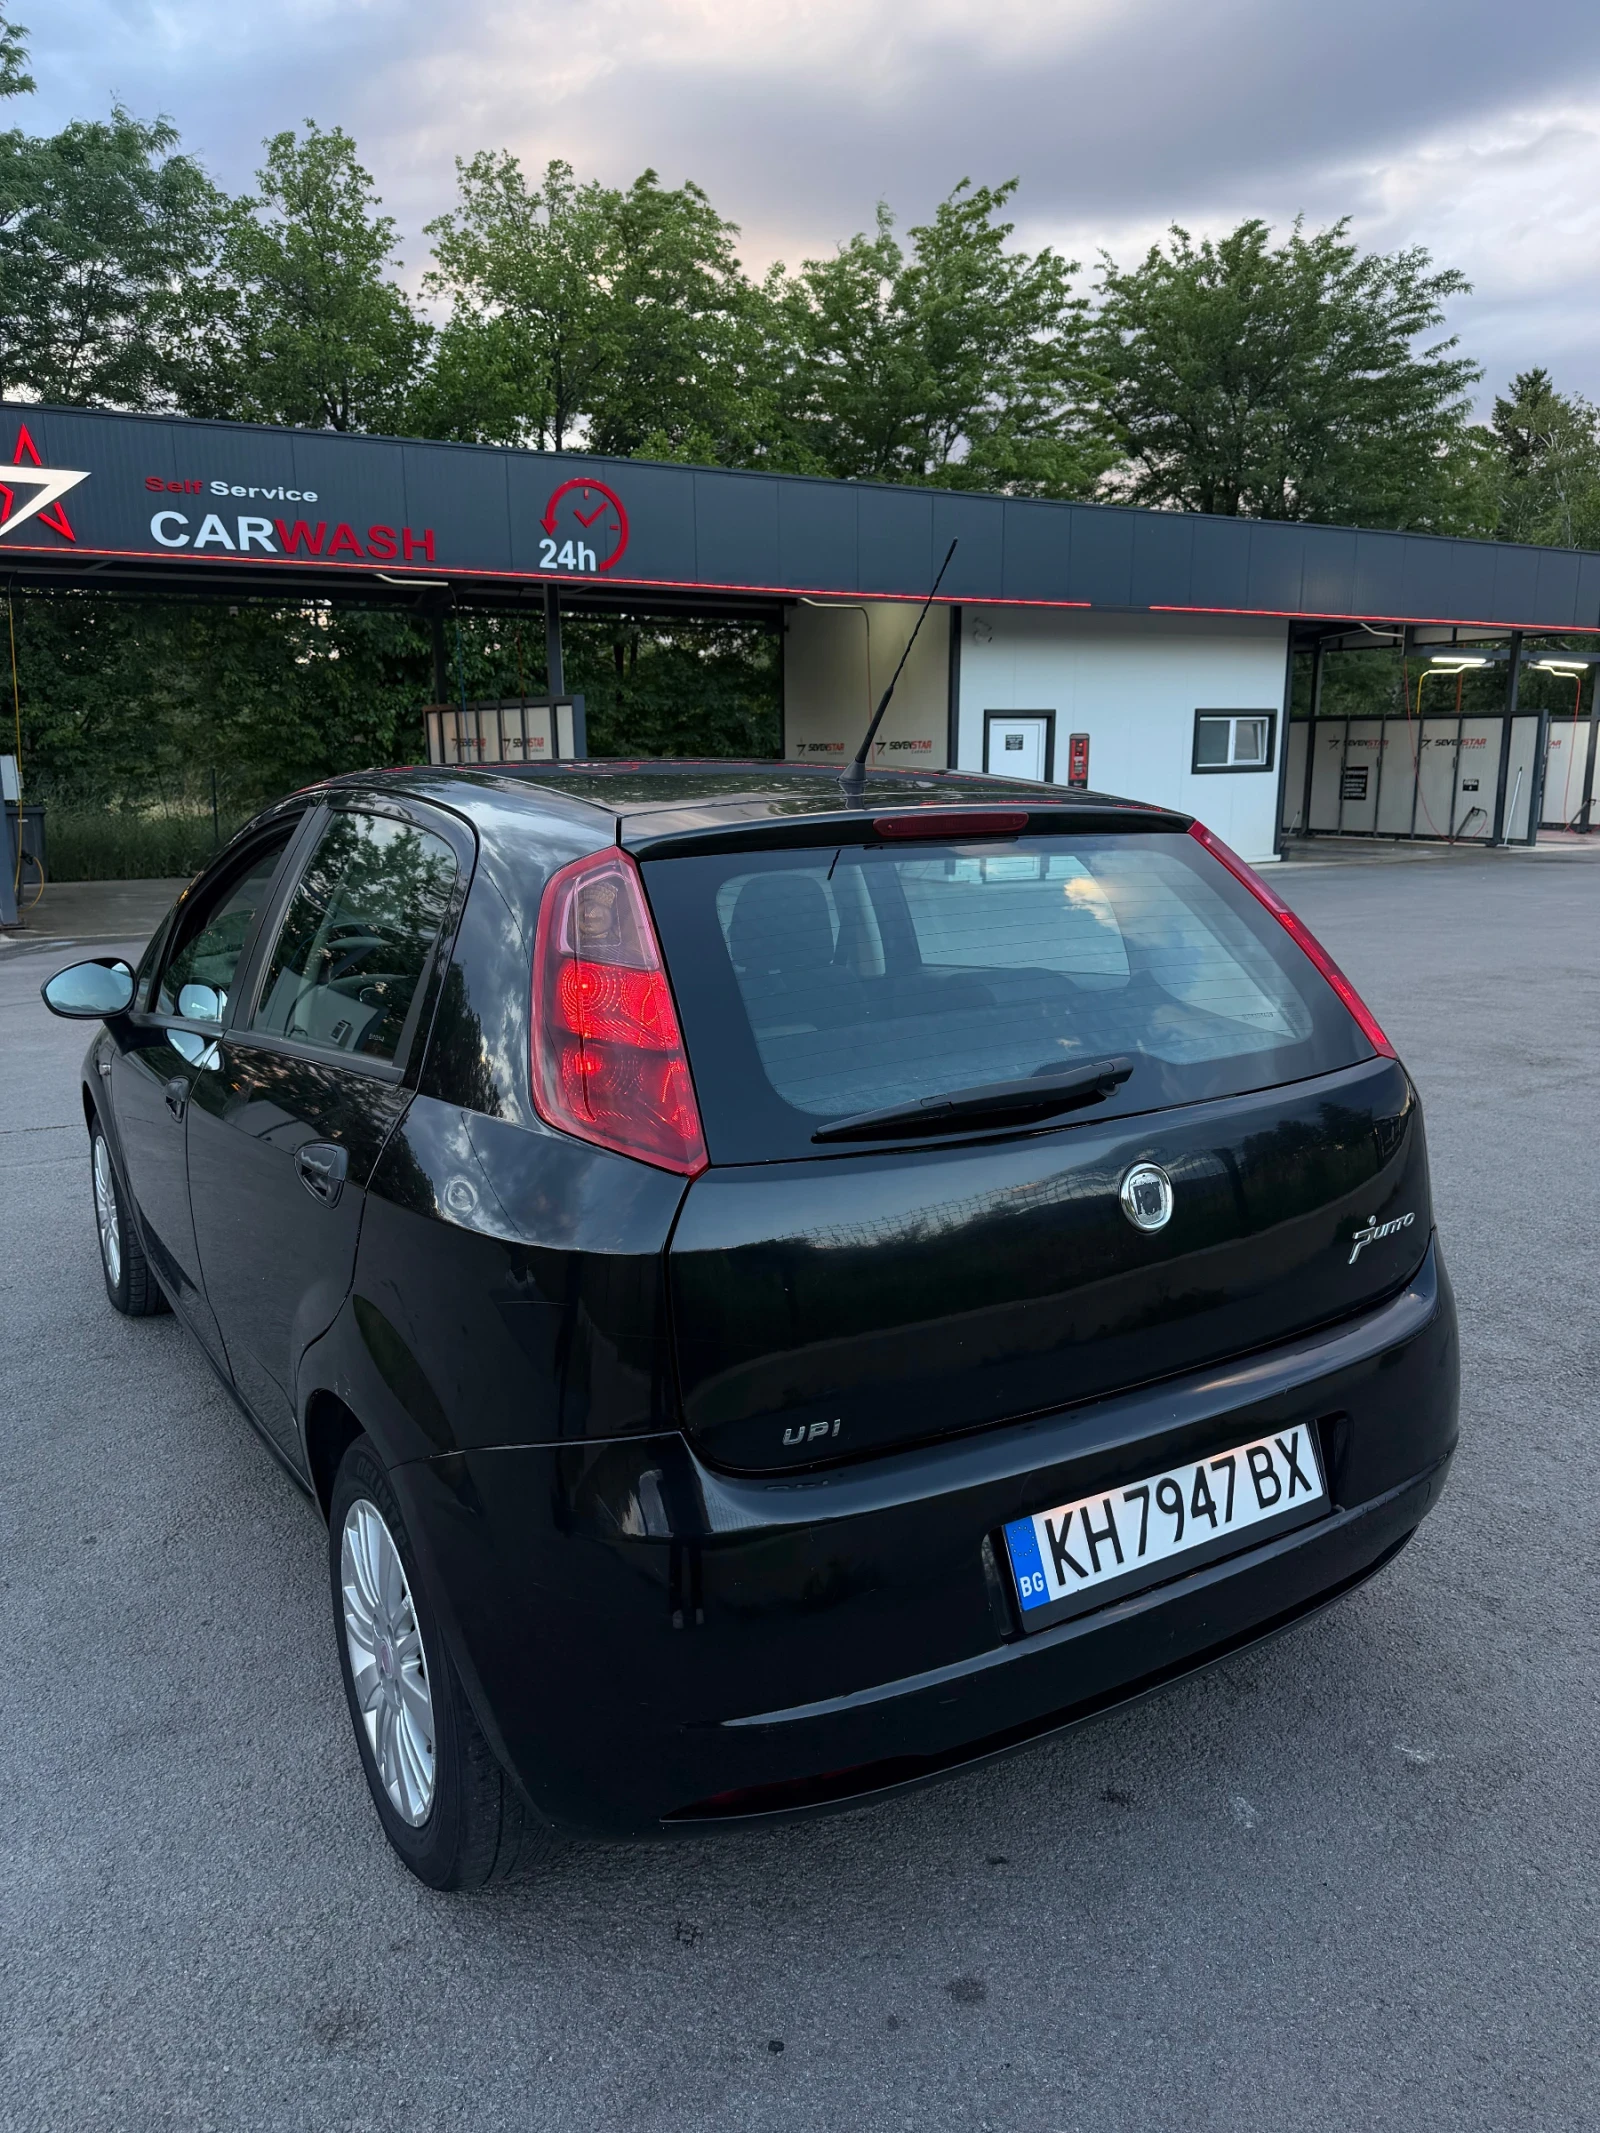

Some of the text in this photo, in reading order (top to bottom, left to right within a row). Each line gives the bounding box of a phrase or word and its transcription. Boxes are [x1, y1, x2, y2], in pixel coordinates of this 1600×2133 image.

[145, 476, 318, 502] Self Service
[150, 510, 436, 562] CARWASH
[539, 538, 597, 572] 24h
[889, 740, 932, 750] SEVENSTAR
[1019, 1571, 1045, 1598] BG
